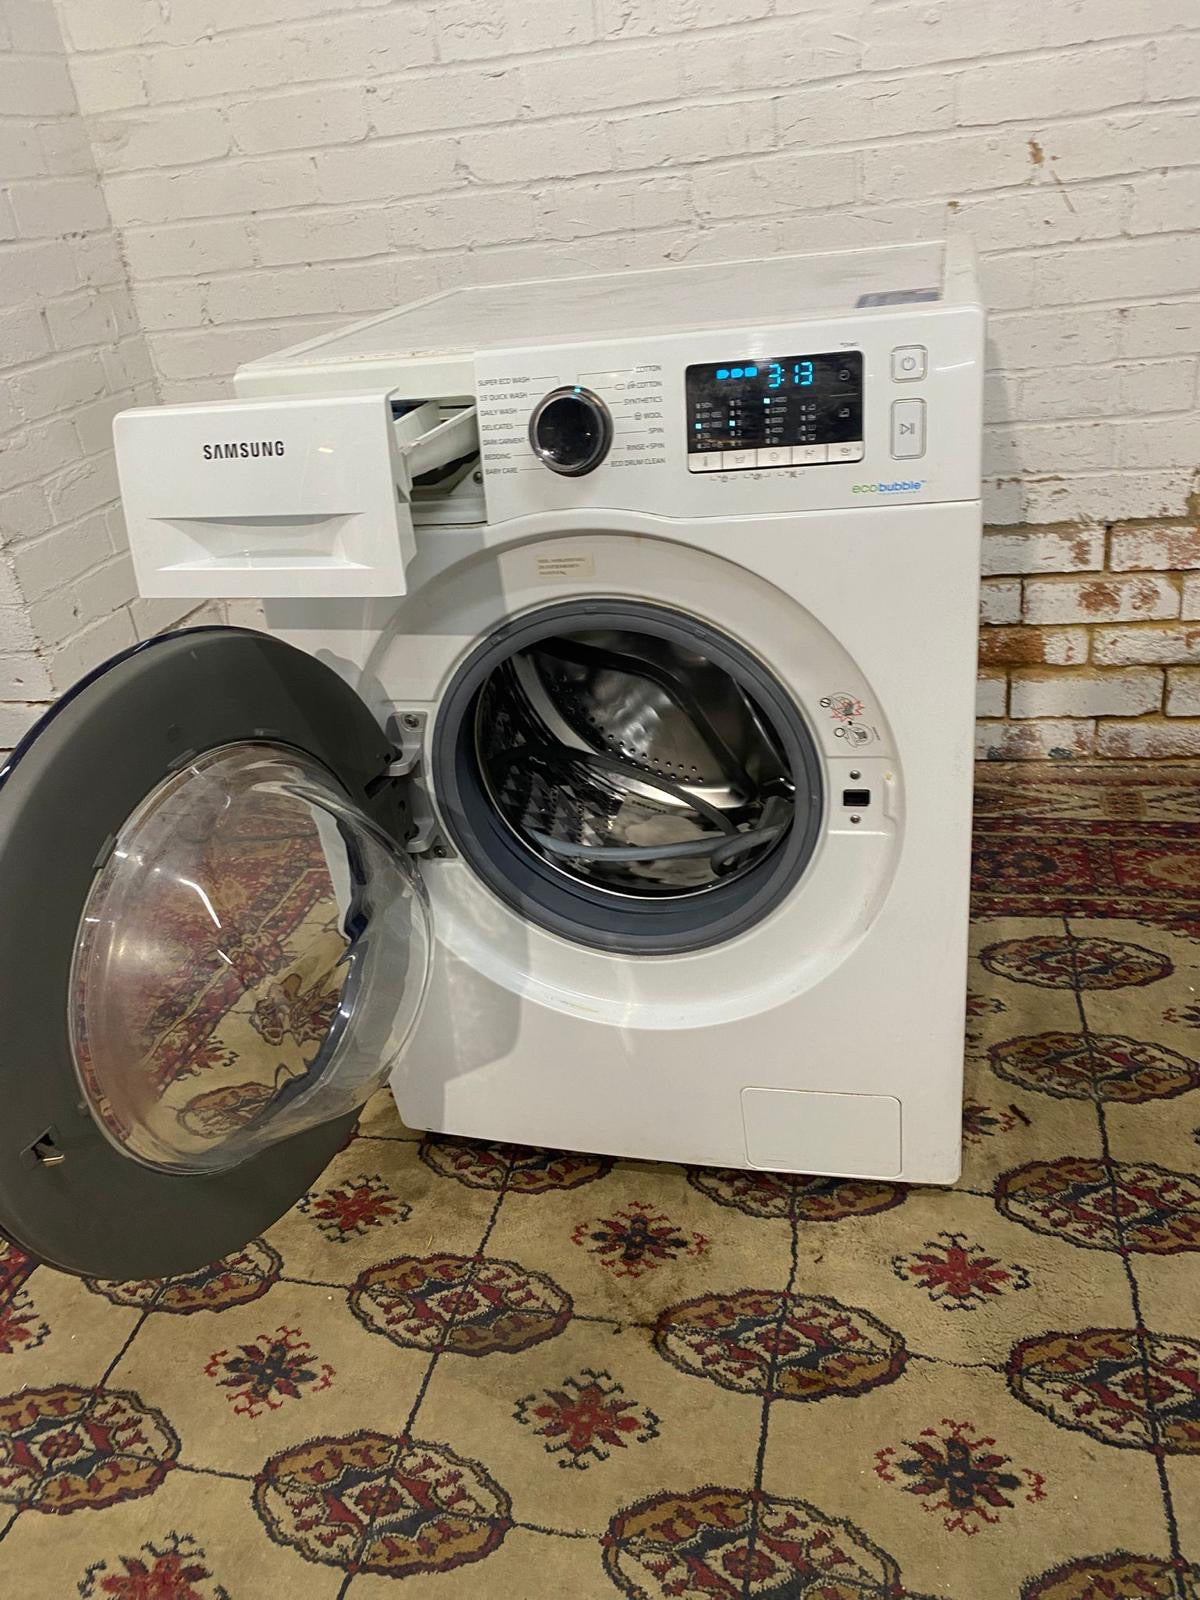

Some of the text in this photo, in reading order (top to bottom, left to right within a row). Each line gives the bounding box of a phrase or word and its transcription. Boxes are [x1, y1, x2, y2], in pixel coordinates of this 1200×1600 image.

[767, 361, 813, 388] 3:13
[478, 378, 497, 387] SUPER
[512, 376, 530, 384] WASH
[489, 393, 508, 401] QUICK
[510, 391, 528, 399] WASH
[623, 396, 663, 406] SYNTHETICS
[480, 407, 518, 417] DAILY WASH
[643, 411, 664, 419] WOOL
[481, 423, 513, 431] DELICATES
[648, 427, 665, 435] SPIN
[203, 440, 285, 460] SAMSUNG
[644, 457, 666, 465] CLEAN
[502, 466, 518, 474] CARE
